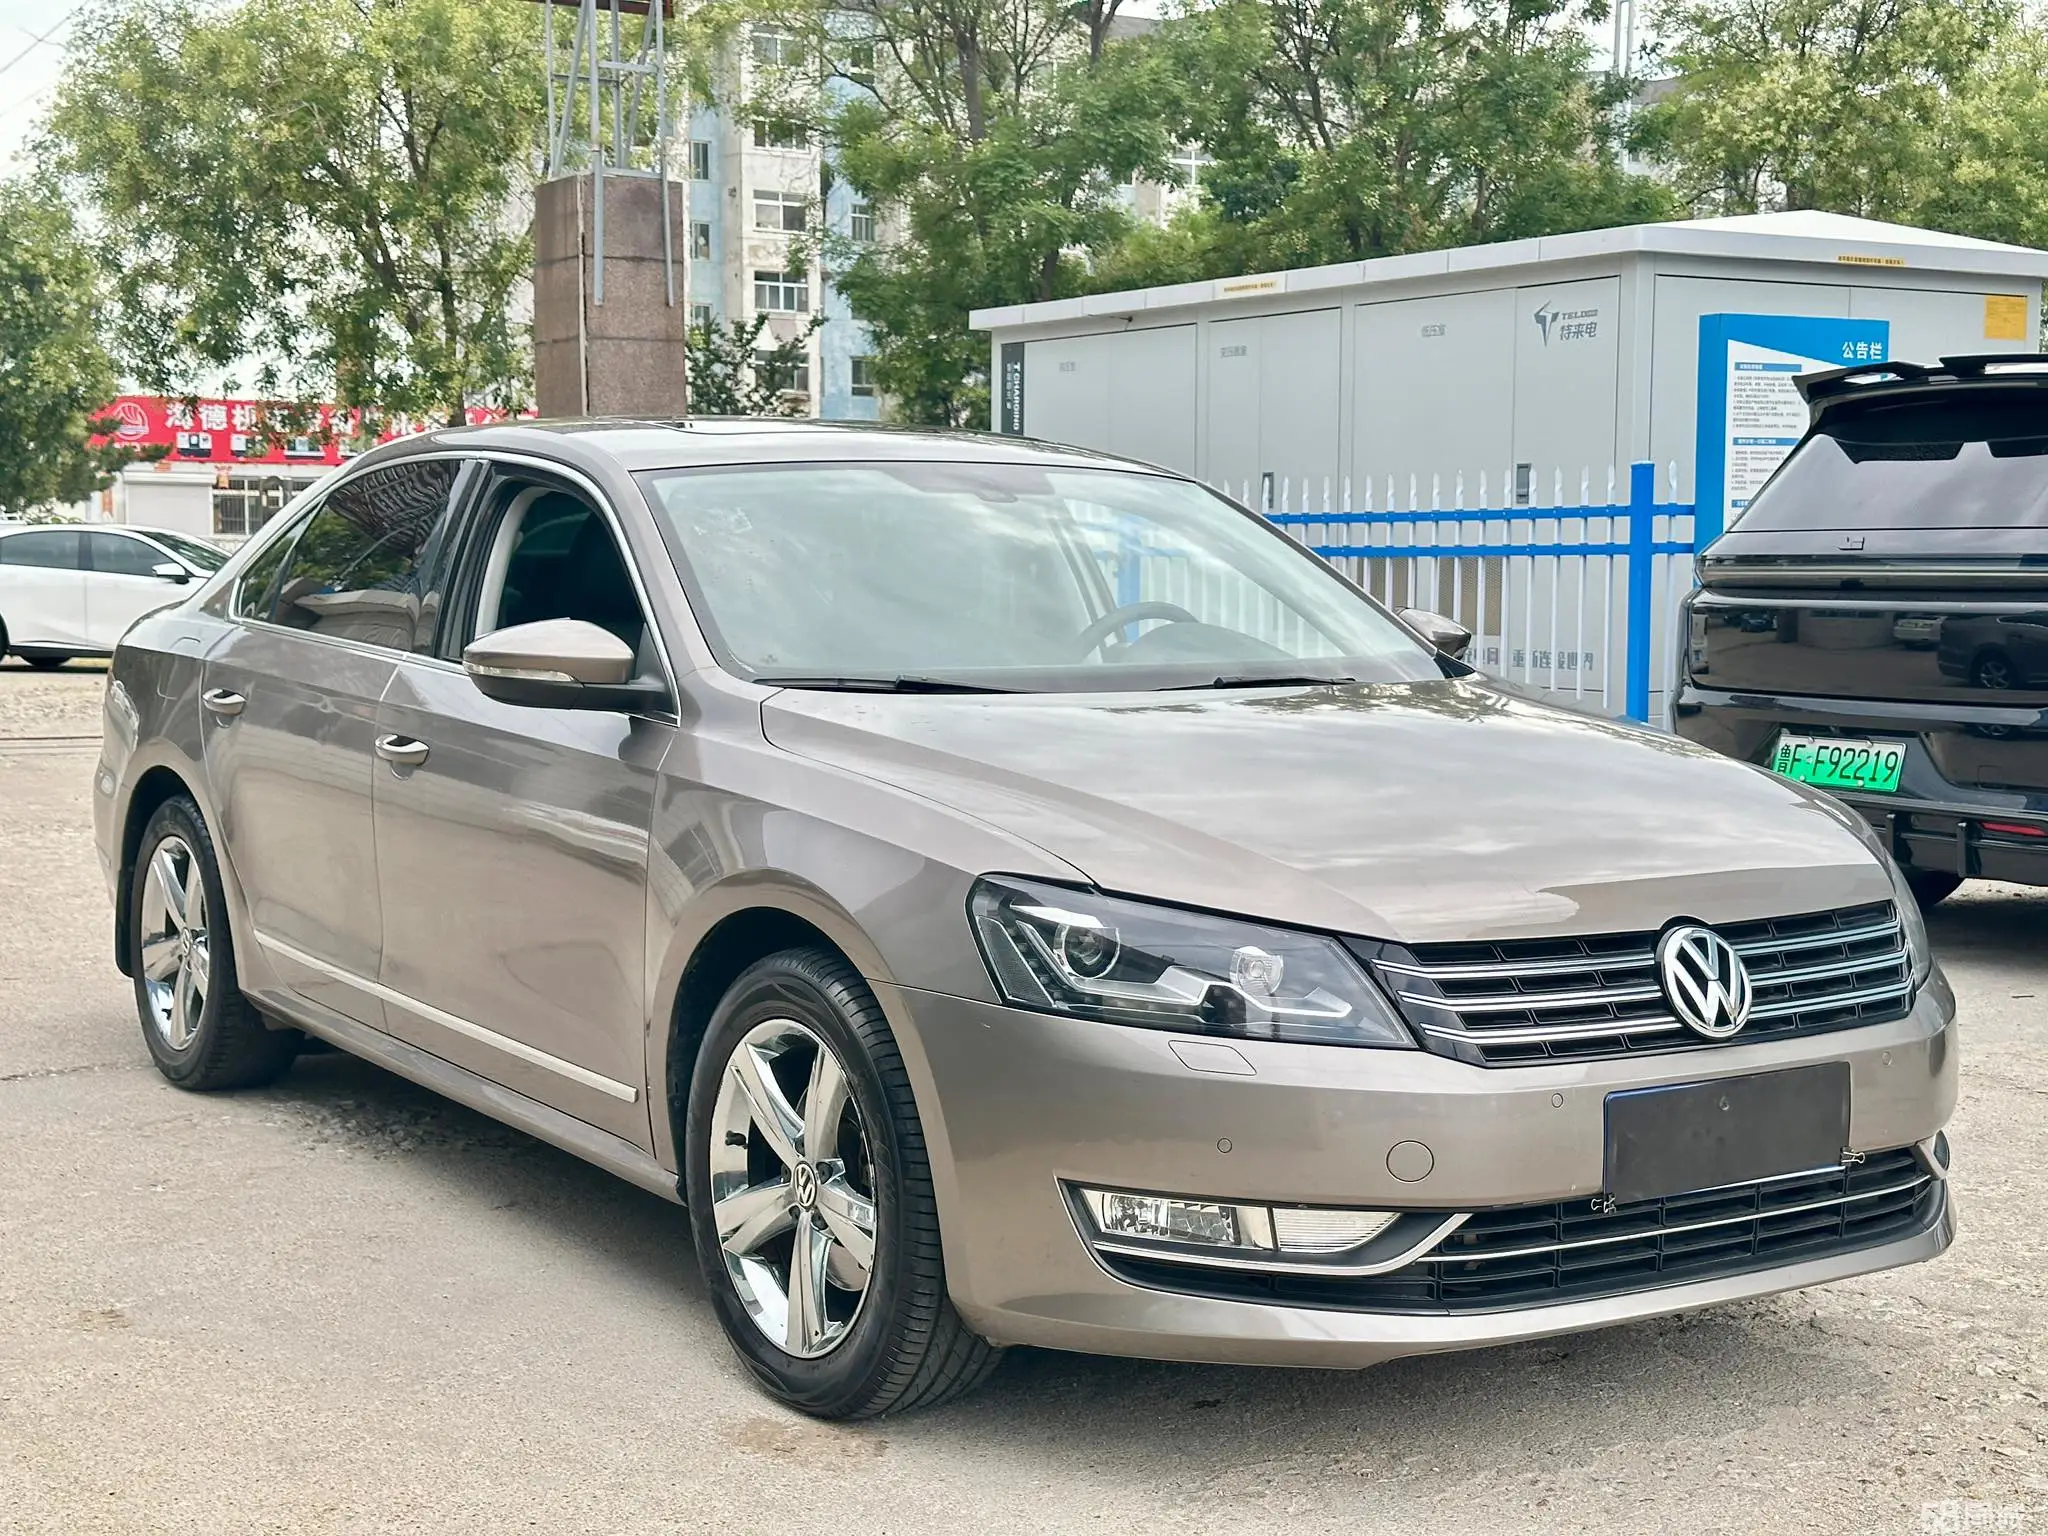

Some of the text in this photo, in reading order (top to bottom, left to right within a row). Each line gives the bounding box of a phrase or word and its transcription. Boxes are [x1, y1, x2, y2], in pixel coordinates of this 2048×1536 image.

[1560, 321, 1597, 341] 特来电
[1842, 341, 1883, 360] 公告栏
